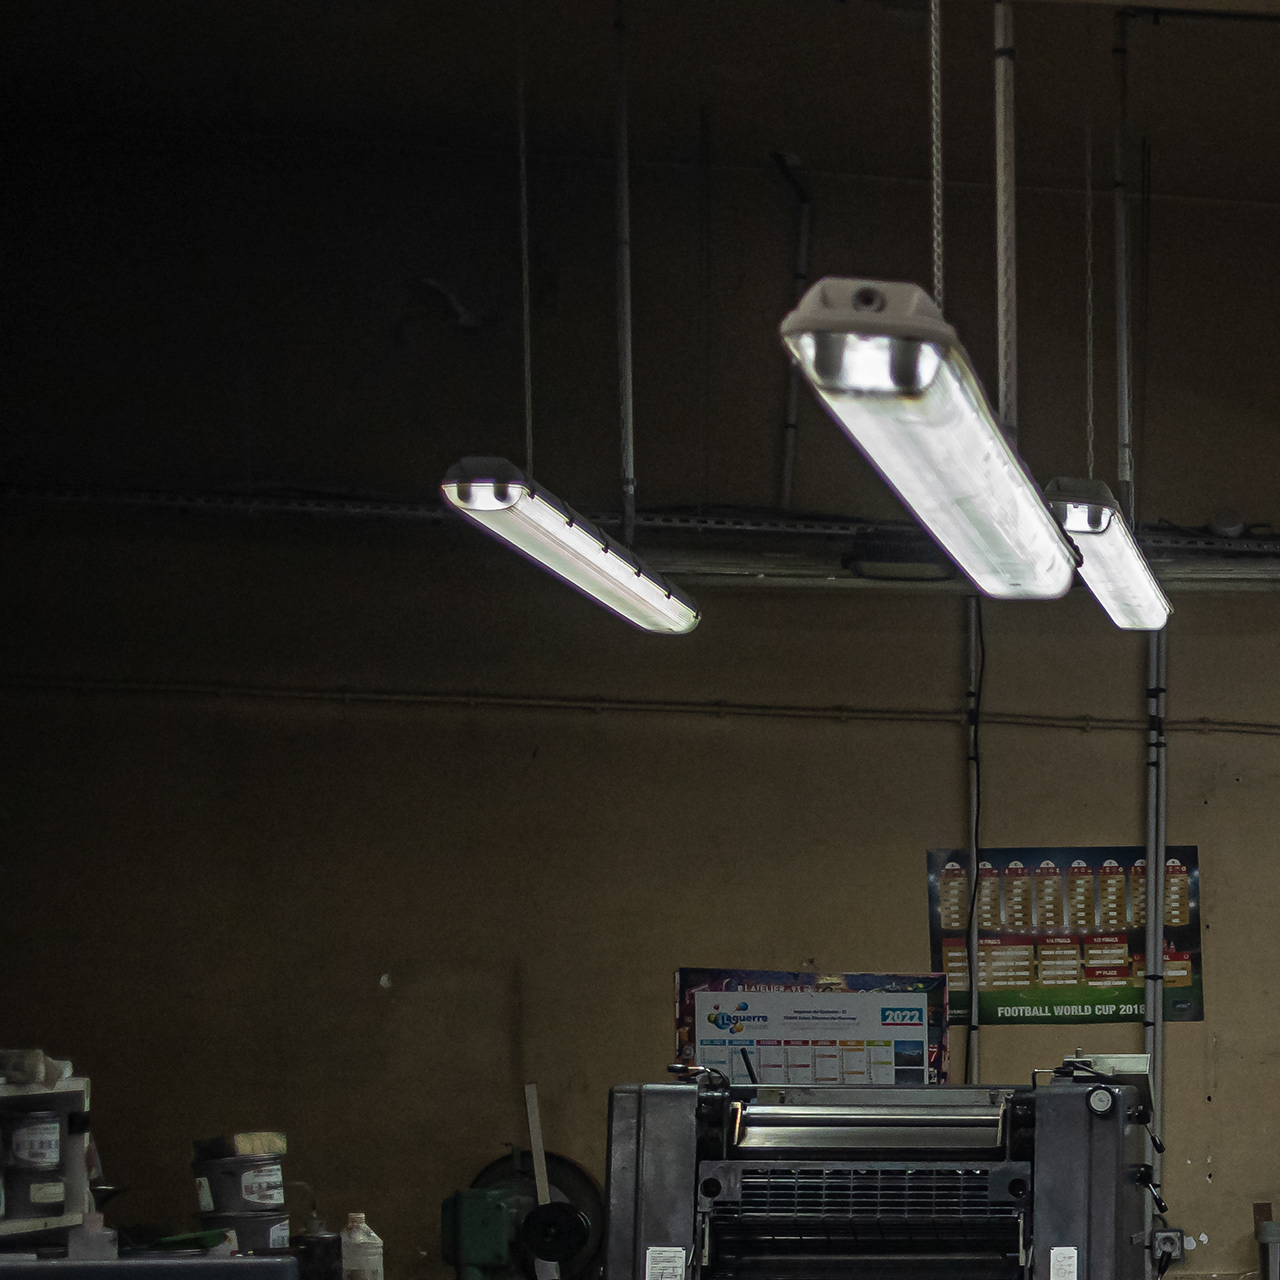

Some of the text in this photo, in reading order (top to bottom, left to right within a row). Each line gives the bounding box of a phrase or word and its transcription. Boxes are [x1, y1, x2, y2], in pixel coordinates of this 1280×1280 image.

[884, 1009, 920, 1023] 2022
[997, 1005, 1051, 1018] FOOTBALL
[1053, 1004, 1092, 1016] WORLD
[1095, 1004, 1116, 1015] CUP
[721, 1013, 768, 1026] Laguerre
